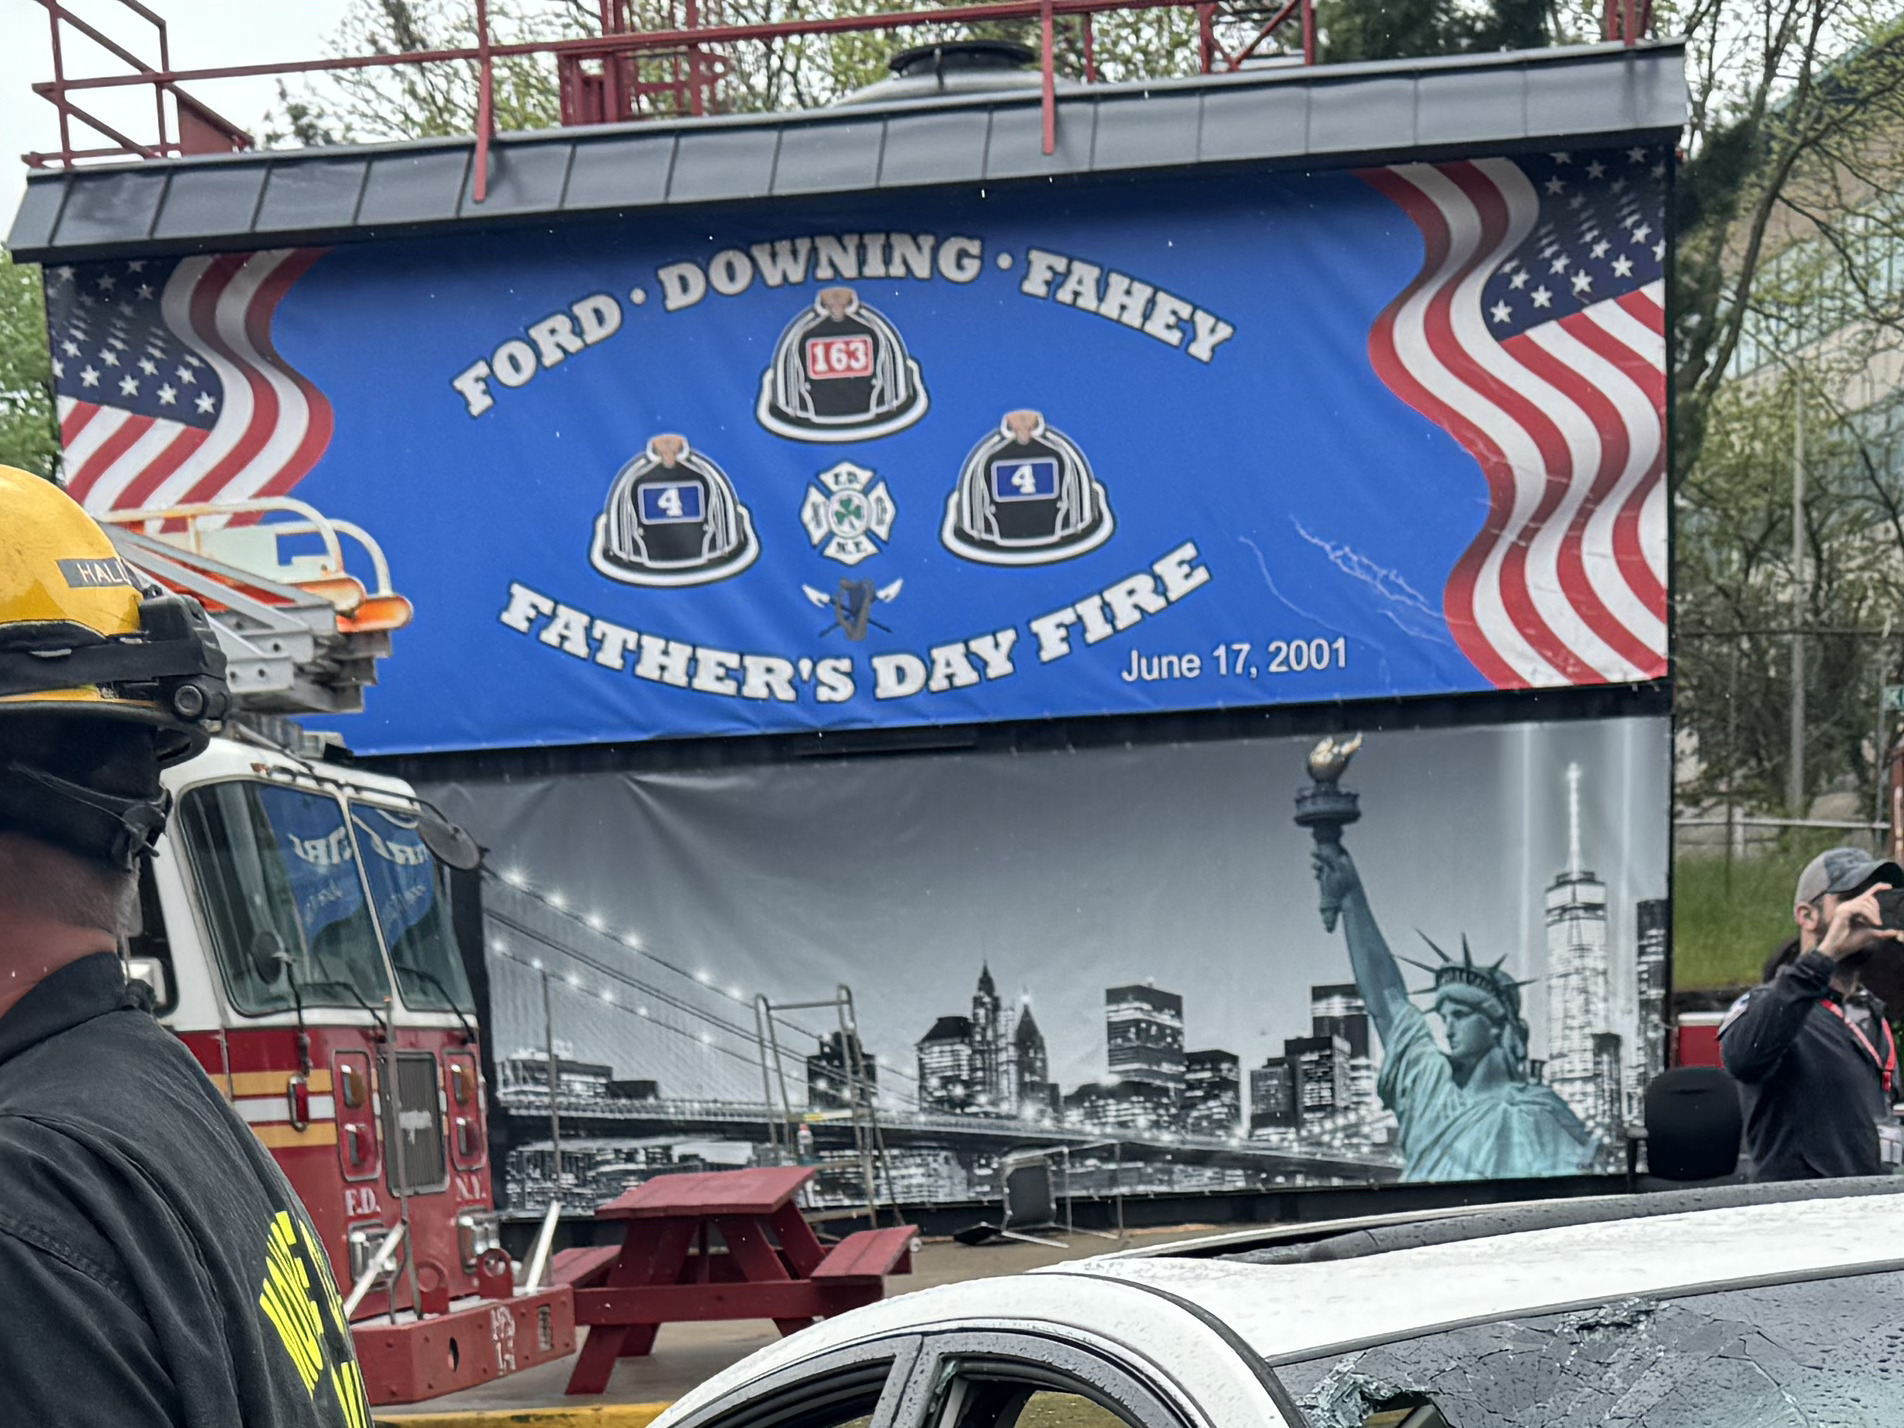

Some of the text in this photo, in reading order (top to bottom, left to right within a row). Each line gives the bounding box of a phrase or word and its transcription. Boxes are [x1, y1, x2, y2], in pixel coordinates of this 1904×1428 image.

[452, 232, 1235, 417] FORD DOWNING FAHEY
[811, 343, 867, 372] 163
[1010, 465, 1036, 494] 4
[657, 488, 683, 516] 4
[499, 541, 1211, 702] FATHER'S DAY FIRE
[1122, 637, 1347, 682] June 17, 2001
